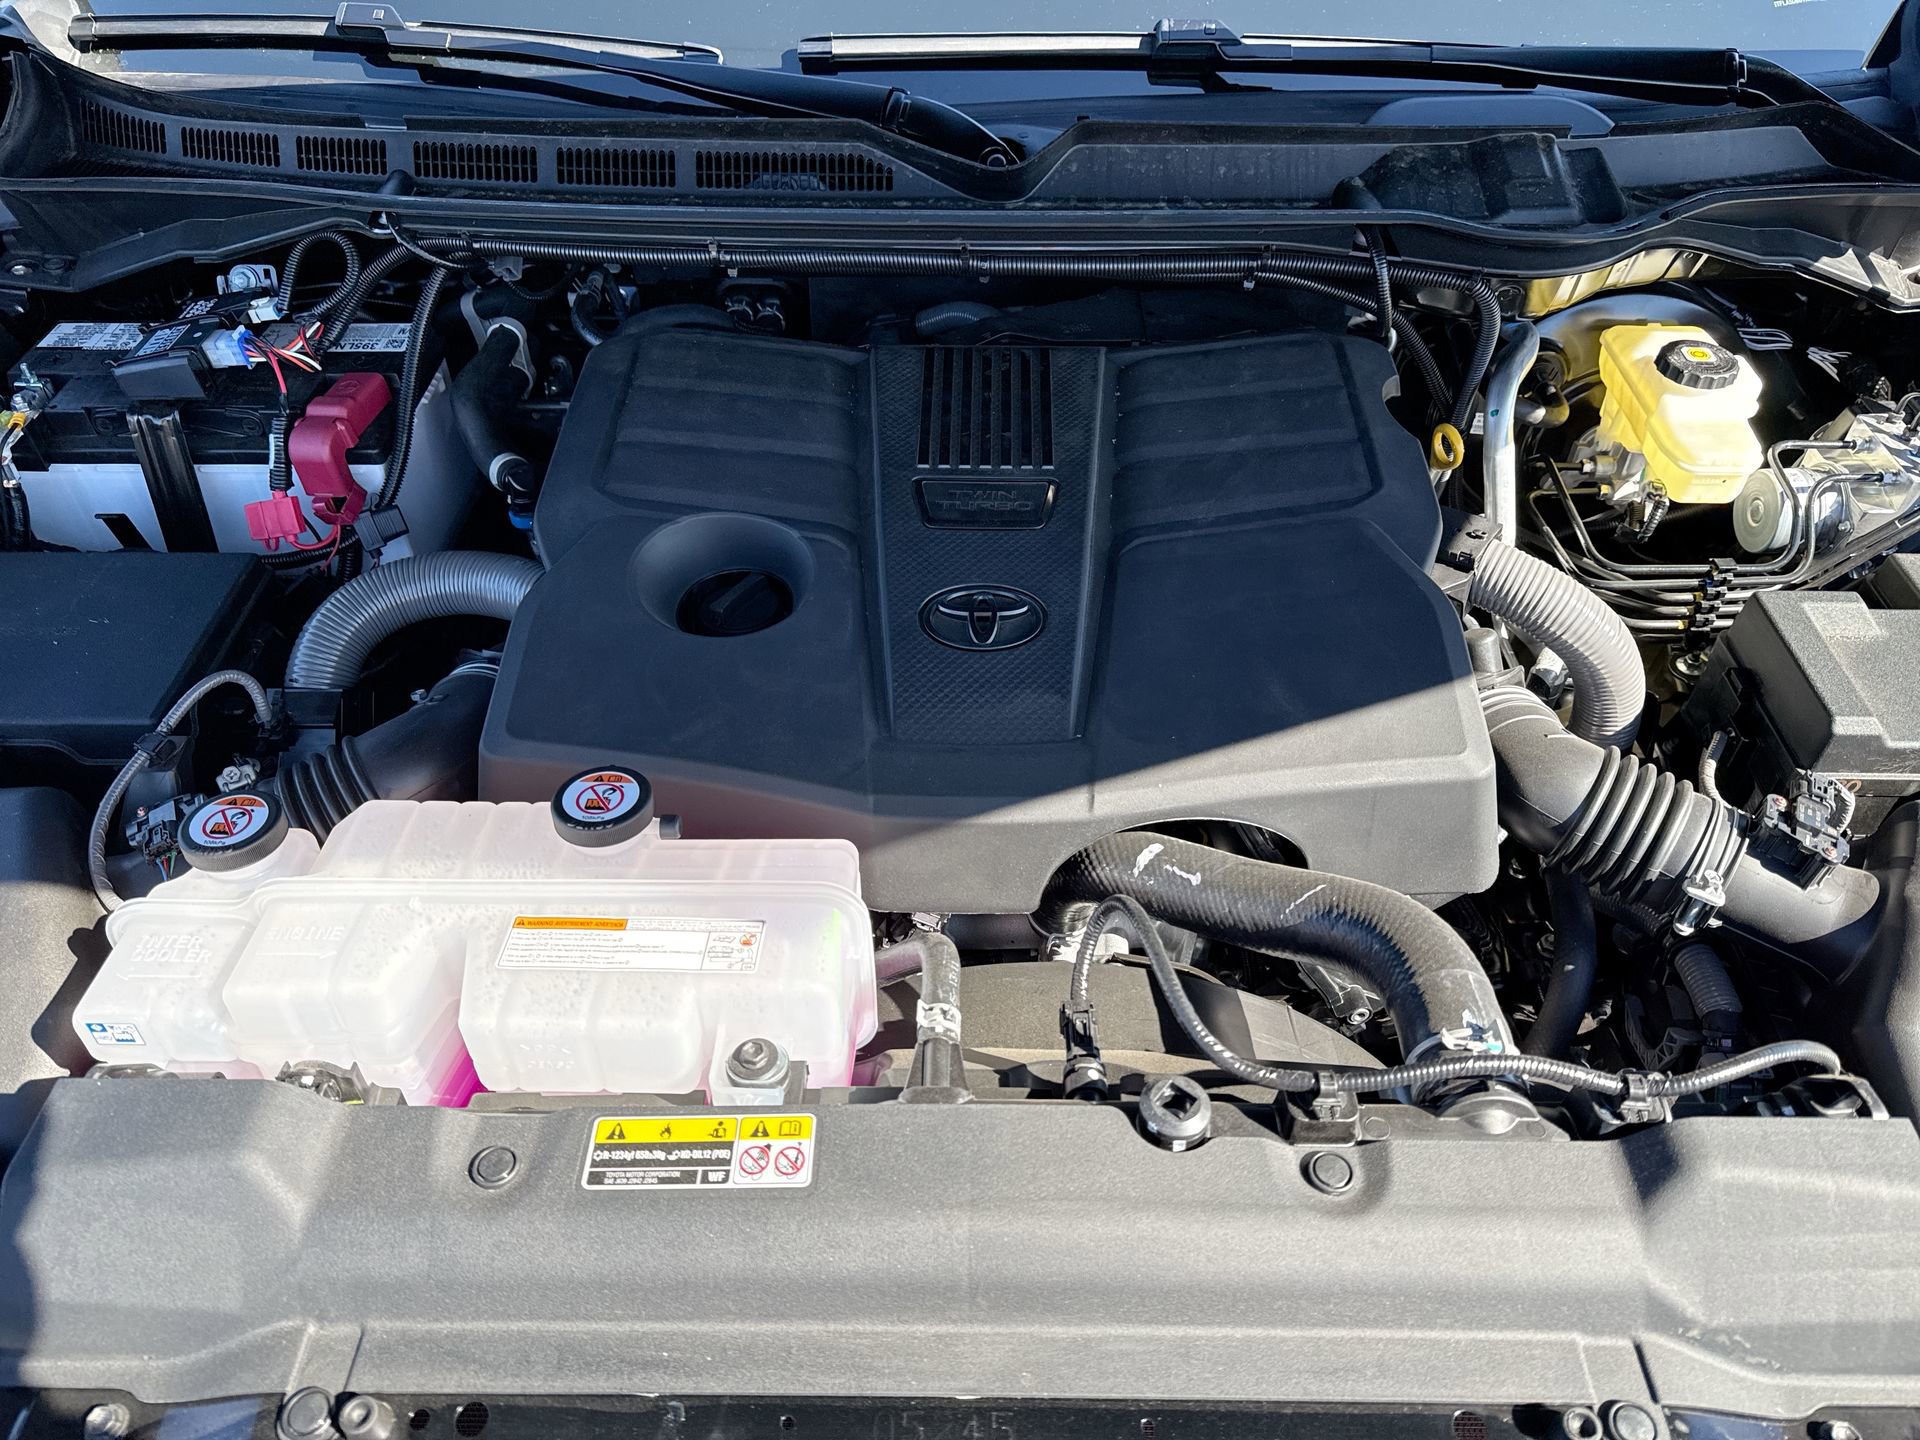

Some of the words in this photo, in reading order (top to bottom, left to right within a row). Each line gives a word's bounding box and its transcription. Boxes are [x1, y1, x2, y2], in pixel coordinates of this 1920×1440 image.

[334, 342, 379, 350] 395LN
[948, 490, 1017, 501] TWIN
[936, 500, 1033, 511] TURBO
[136, 935, 204, 949] INTER
[129, 948, 212, 963] COOLER
[708, 1171, 726, 1182] WF
